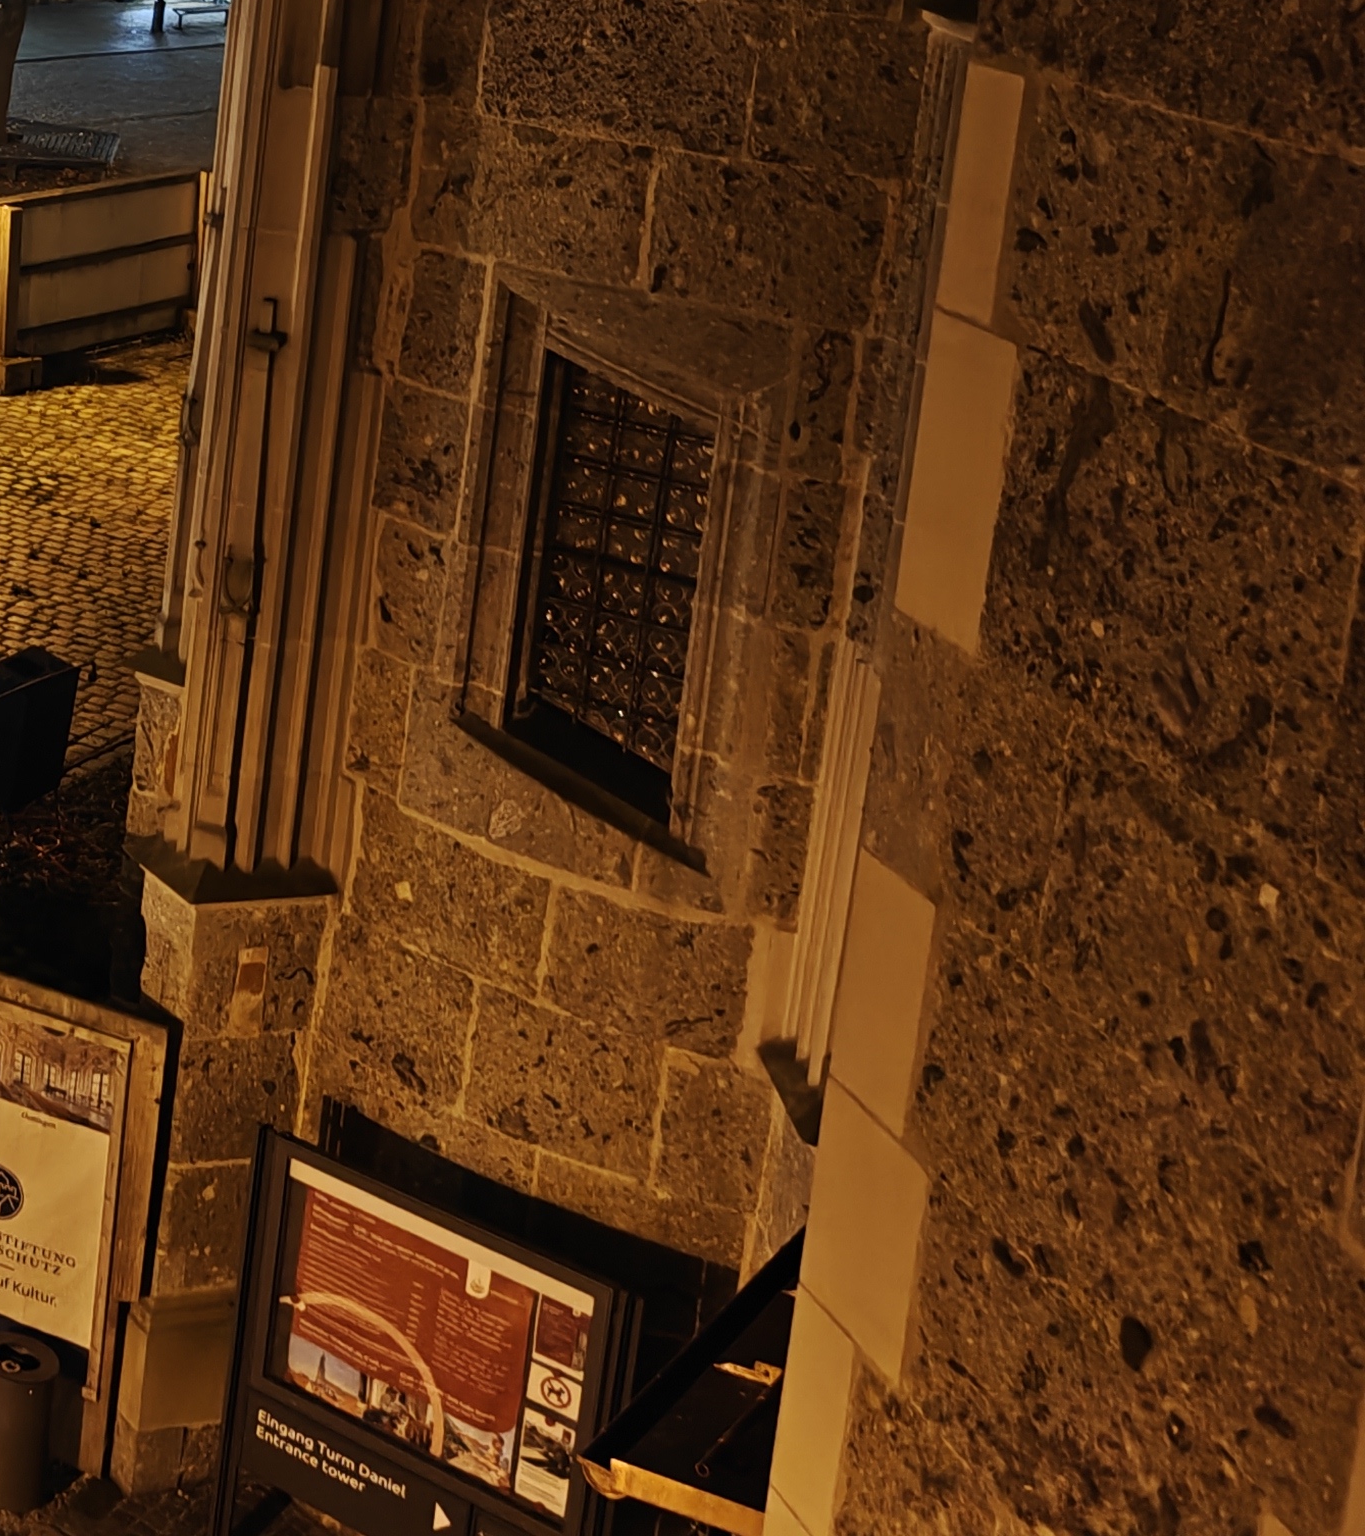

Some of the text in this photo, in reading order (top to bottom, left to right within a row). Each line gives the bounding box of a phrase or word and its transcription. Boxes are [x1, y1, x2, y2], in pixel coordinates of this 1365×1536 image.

[12, 1279, 58, 1307] Kultur.
[255, 1424, 366, 1493] Entrance tower
[257, 1409, 406, 1499] Eingang Turm Daniel
